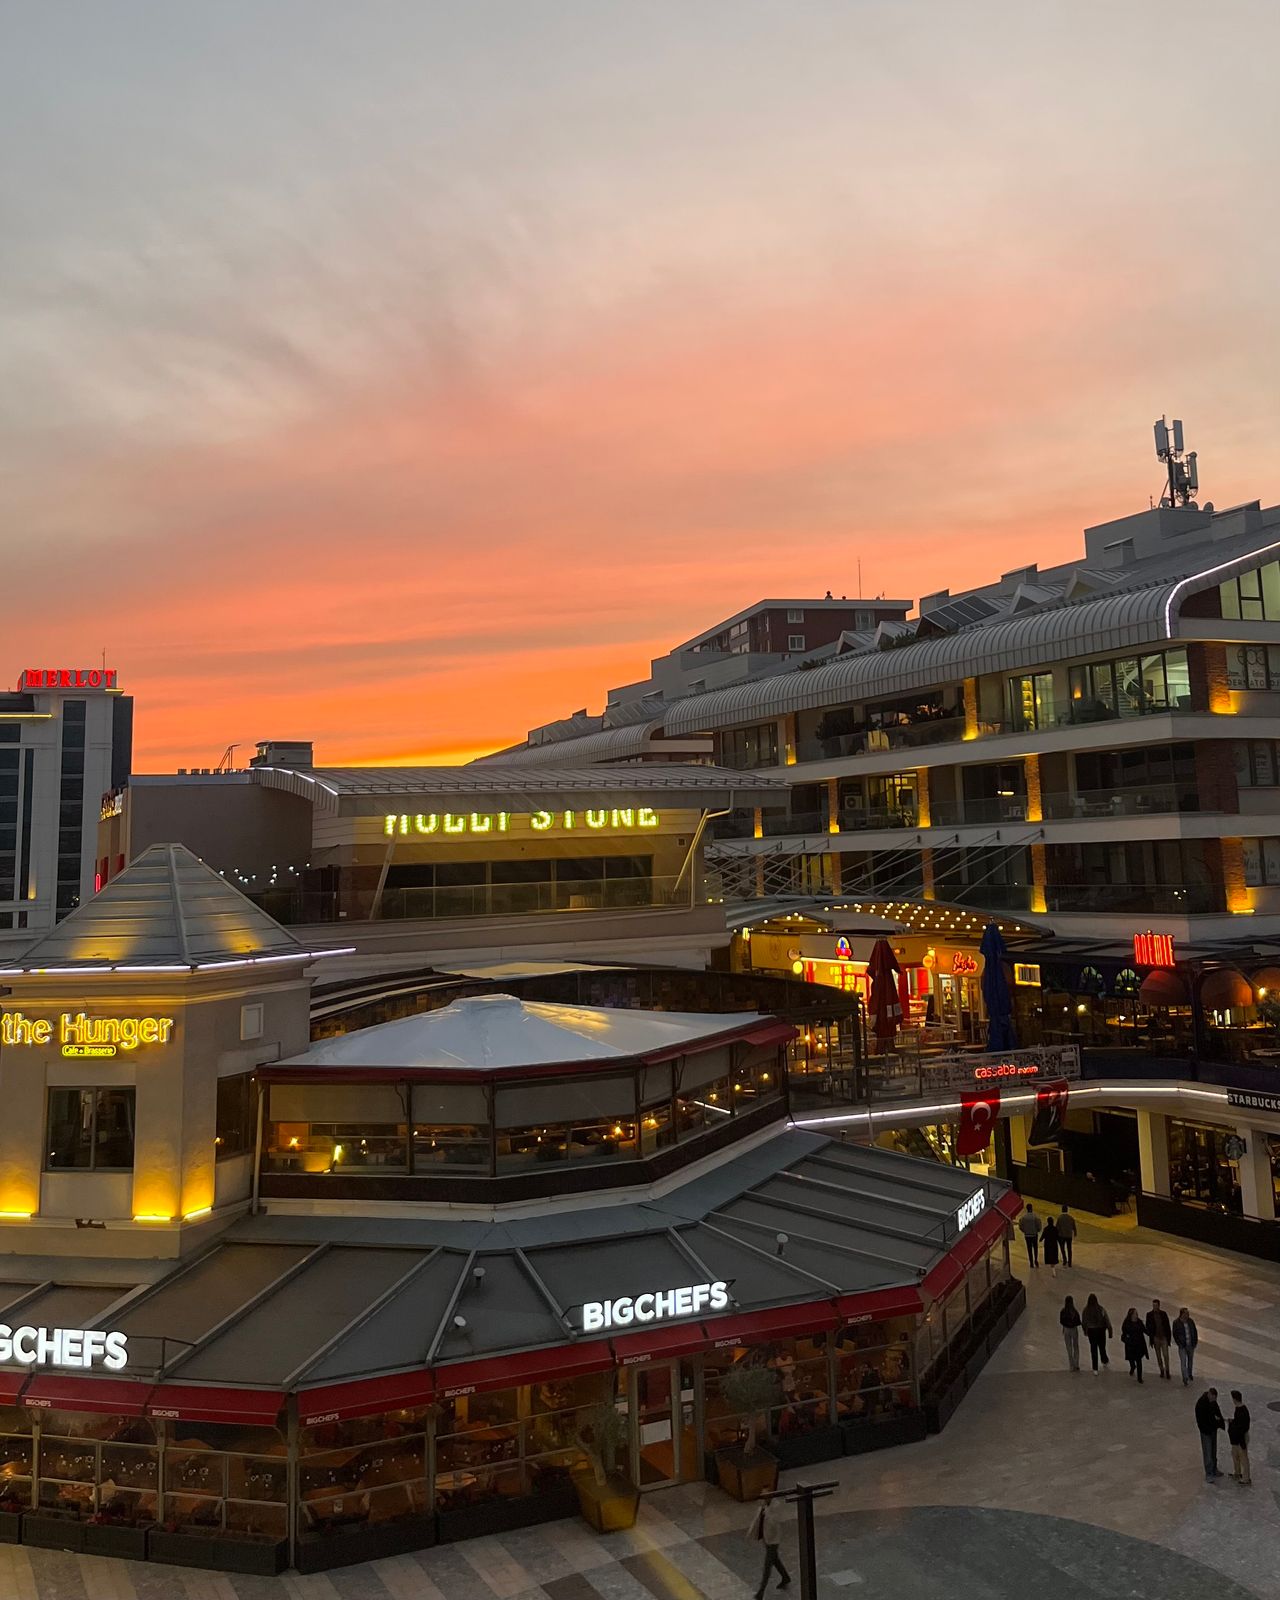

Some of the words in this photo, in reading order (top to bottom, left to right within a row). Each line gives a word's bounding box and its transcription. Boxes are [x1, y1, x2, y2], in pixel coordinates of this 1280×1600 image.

[26, 669, 115, 687] MERLOT
[1, 1013, 52, 1043] the
[61, 1012, 173, 1049] Hunger
[958, 1188, 985, 1232] BIGCHEFS
[583, 1281, 728, 1332] BIGCHEFS
[444, 1386, 476, 1397] BIGCHEFS
[306, 1413, 340, 1425] BIGCHEFS
